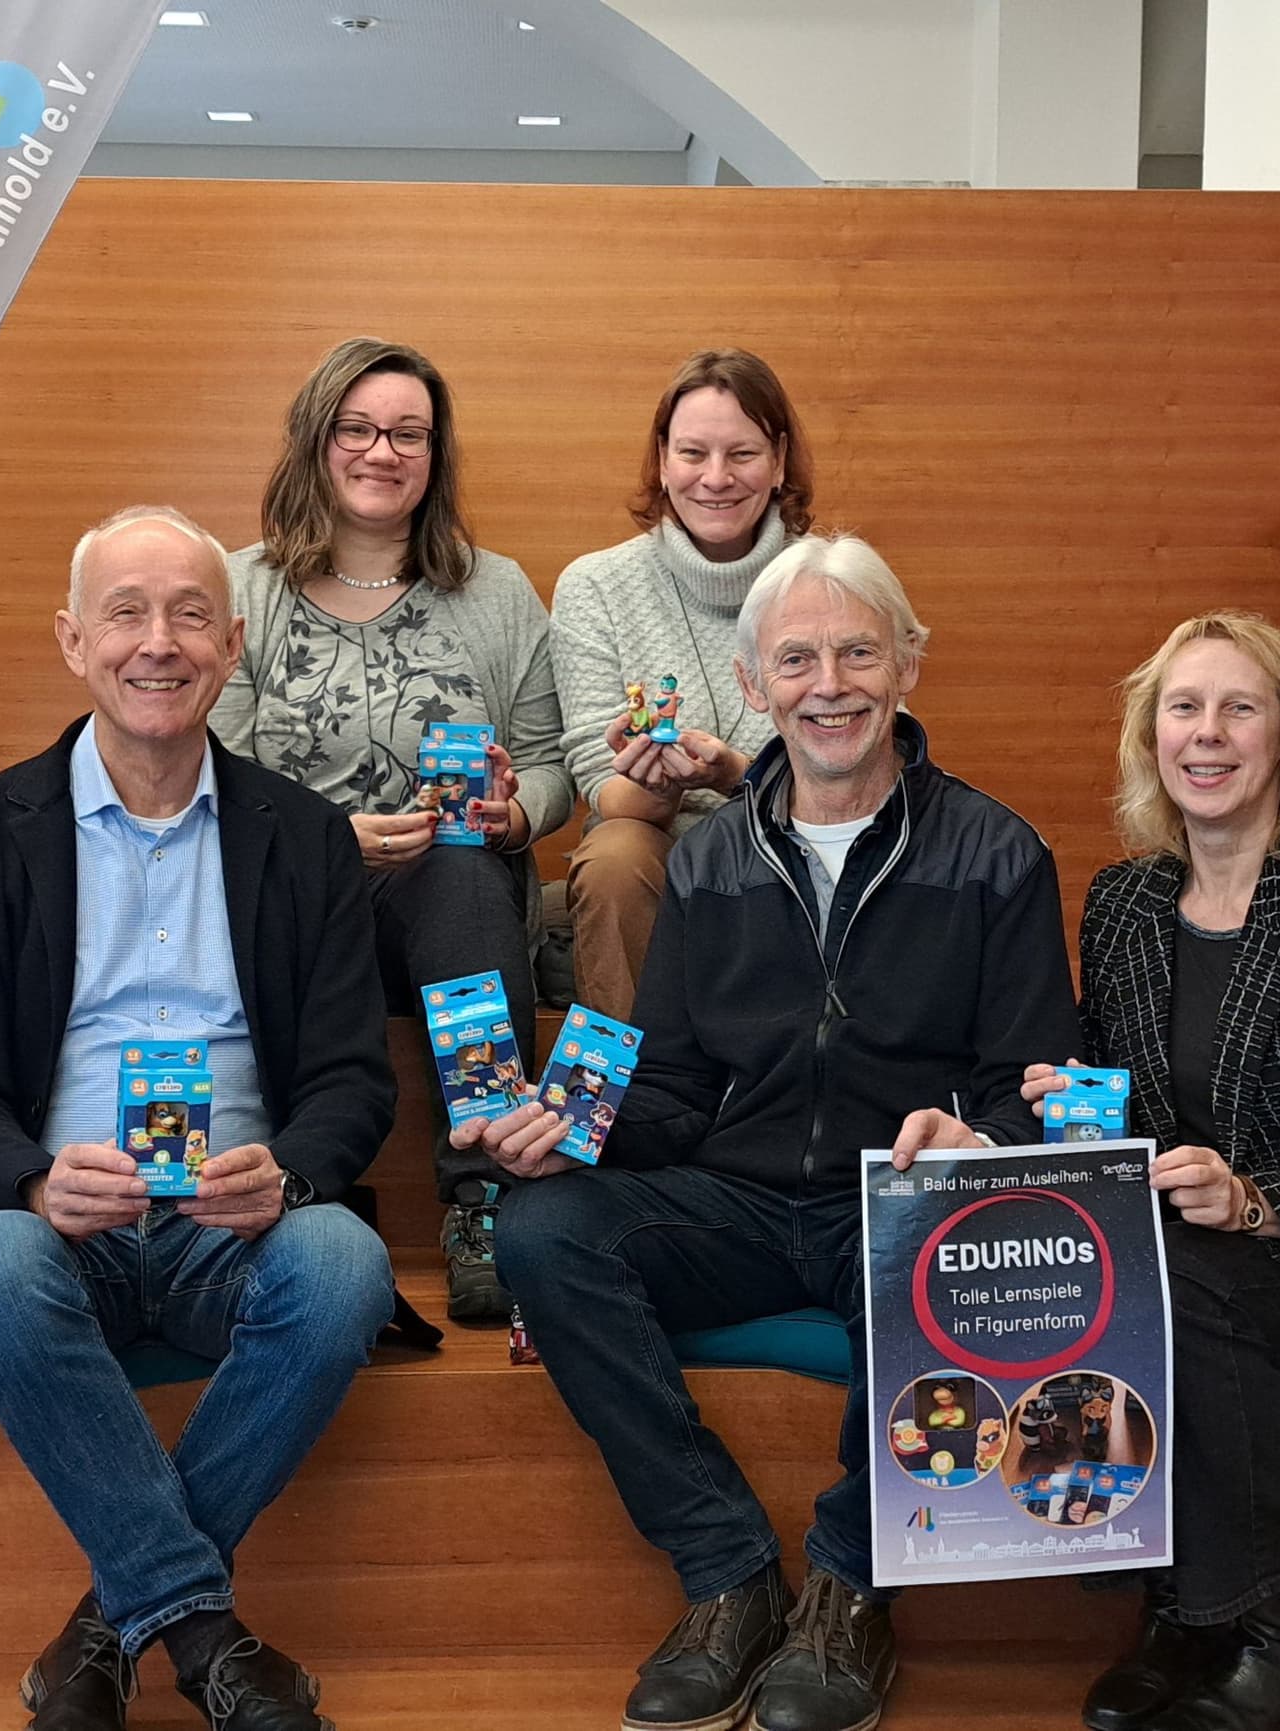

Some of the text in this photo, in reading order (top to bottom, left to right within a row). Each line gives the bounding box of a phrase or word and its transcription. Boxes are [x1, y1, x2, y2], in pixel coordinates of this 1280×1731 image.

[40, 60, 96, 136] e.V.
[924, 1177, 956, 1192] Bald
[960, 1176, 986, 1190] hier
[991, 1177, 1019, 1188] zum
[1022, 1170, 1093, 1186] Ausleihen:
[938, 1236, 1095, 1273] EDURINOs
[950, 1282, 1082, 1309] Tolle Lernspiele
[953, 1313, 1086, 1337] in Figurenform
